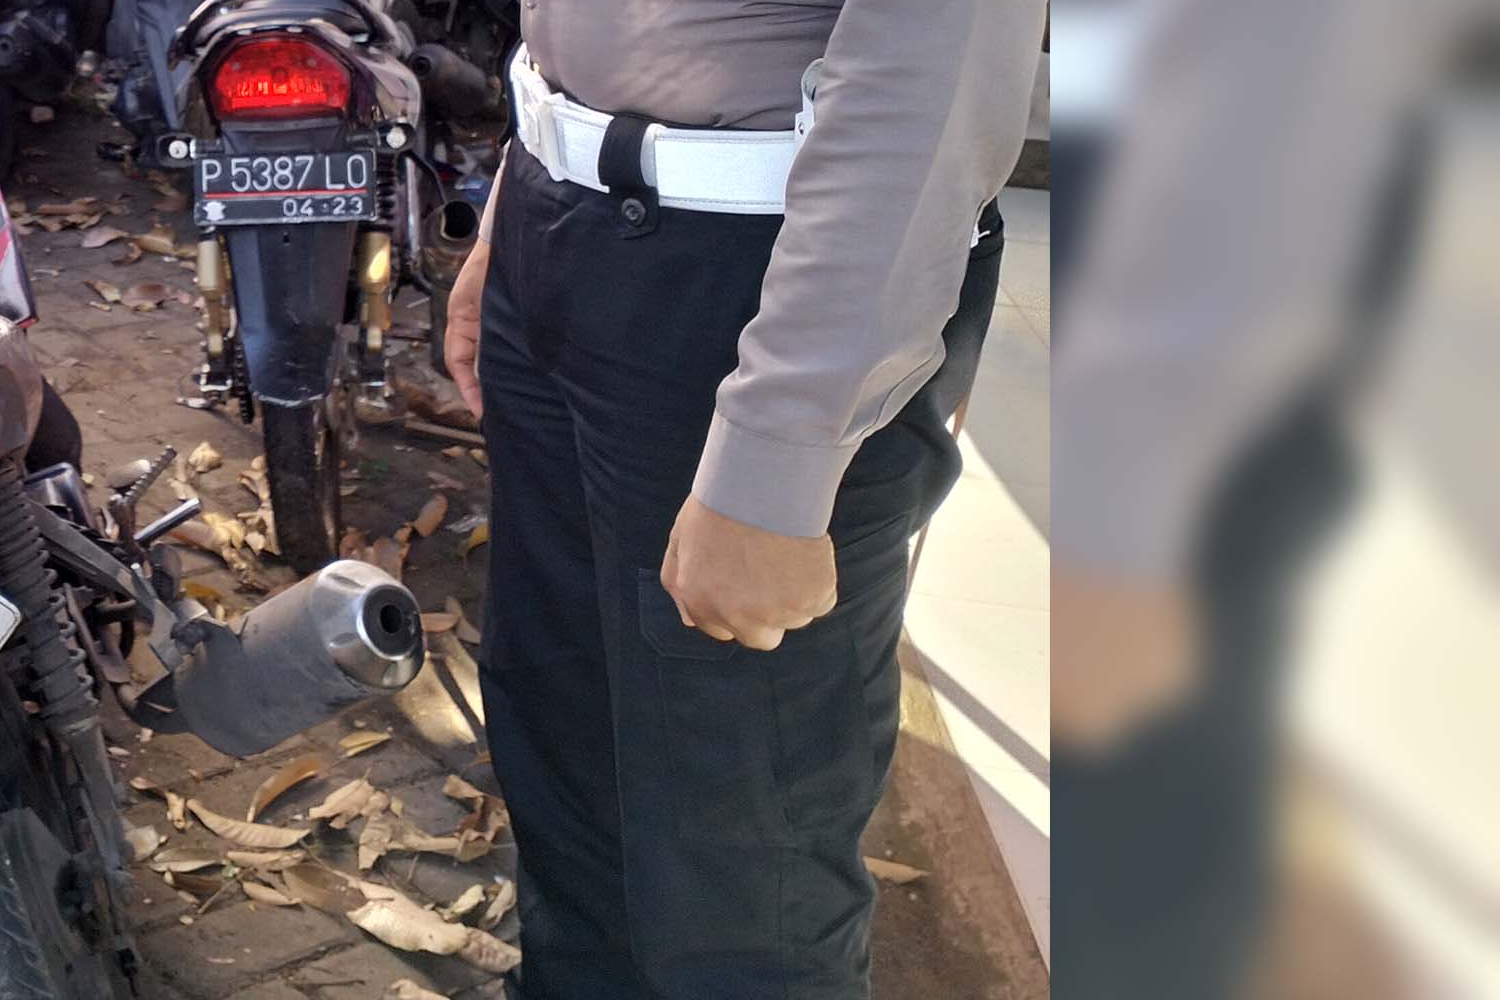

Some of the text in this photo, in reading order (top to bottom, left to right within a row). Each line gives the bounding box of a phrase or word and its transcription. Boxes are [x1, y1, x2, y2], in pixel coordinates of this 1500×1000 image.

[202, 154, 367, 192] P 5387 LO
